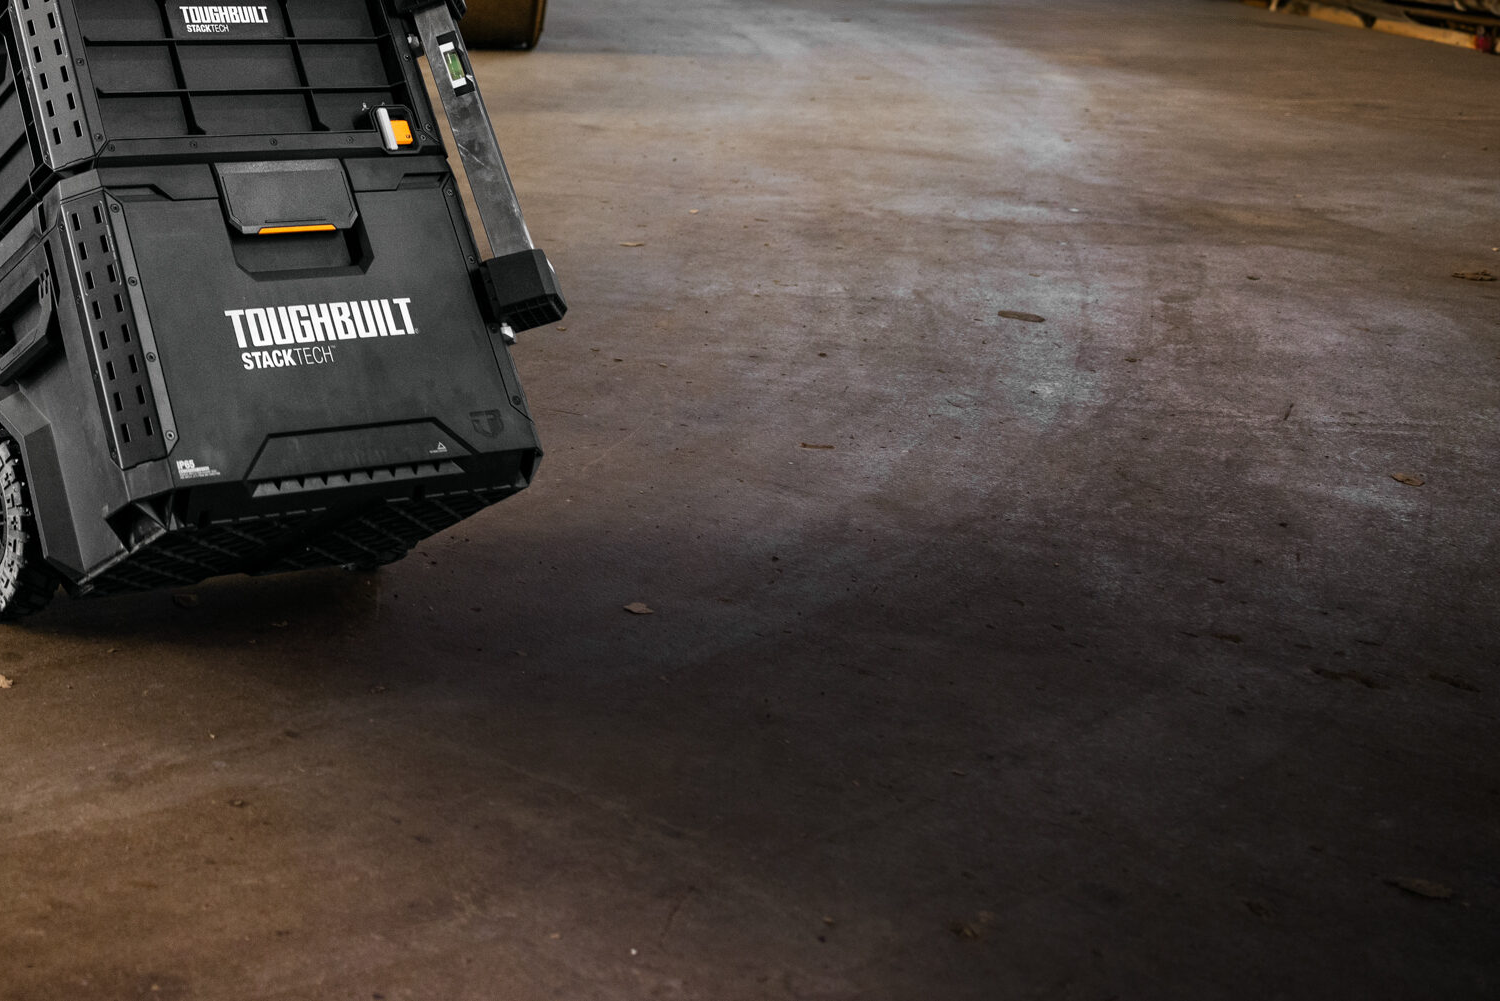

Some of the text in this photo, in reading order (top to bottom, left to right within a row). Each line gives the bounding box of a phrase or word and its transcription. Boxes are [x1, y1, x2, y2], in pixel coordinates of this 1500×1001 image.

[179, 5, 269, 24] TOUGHBUILT
[186, 23, 230, 33] STACKTECH
[224, 297, 416, 349] TOUGHBUILT
[240, 345, 334, 370] STACKTECH
[176, 459, 195, 470] IP65
